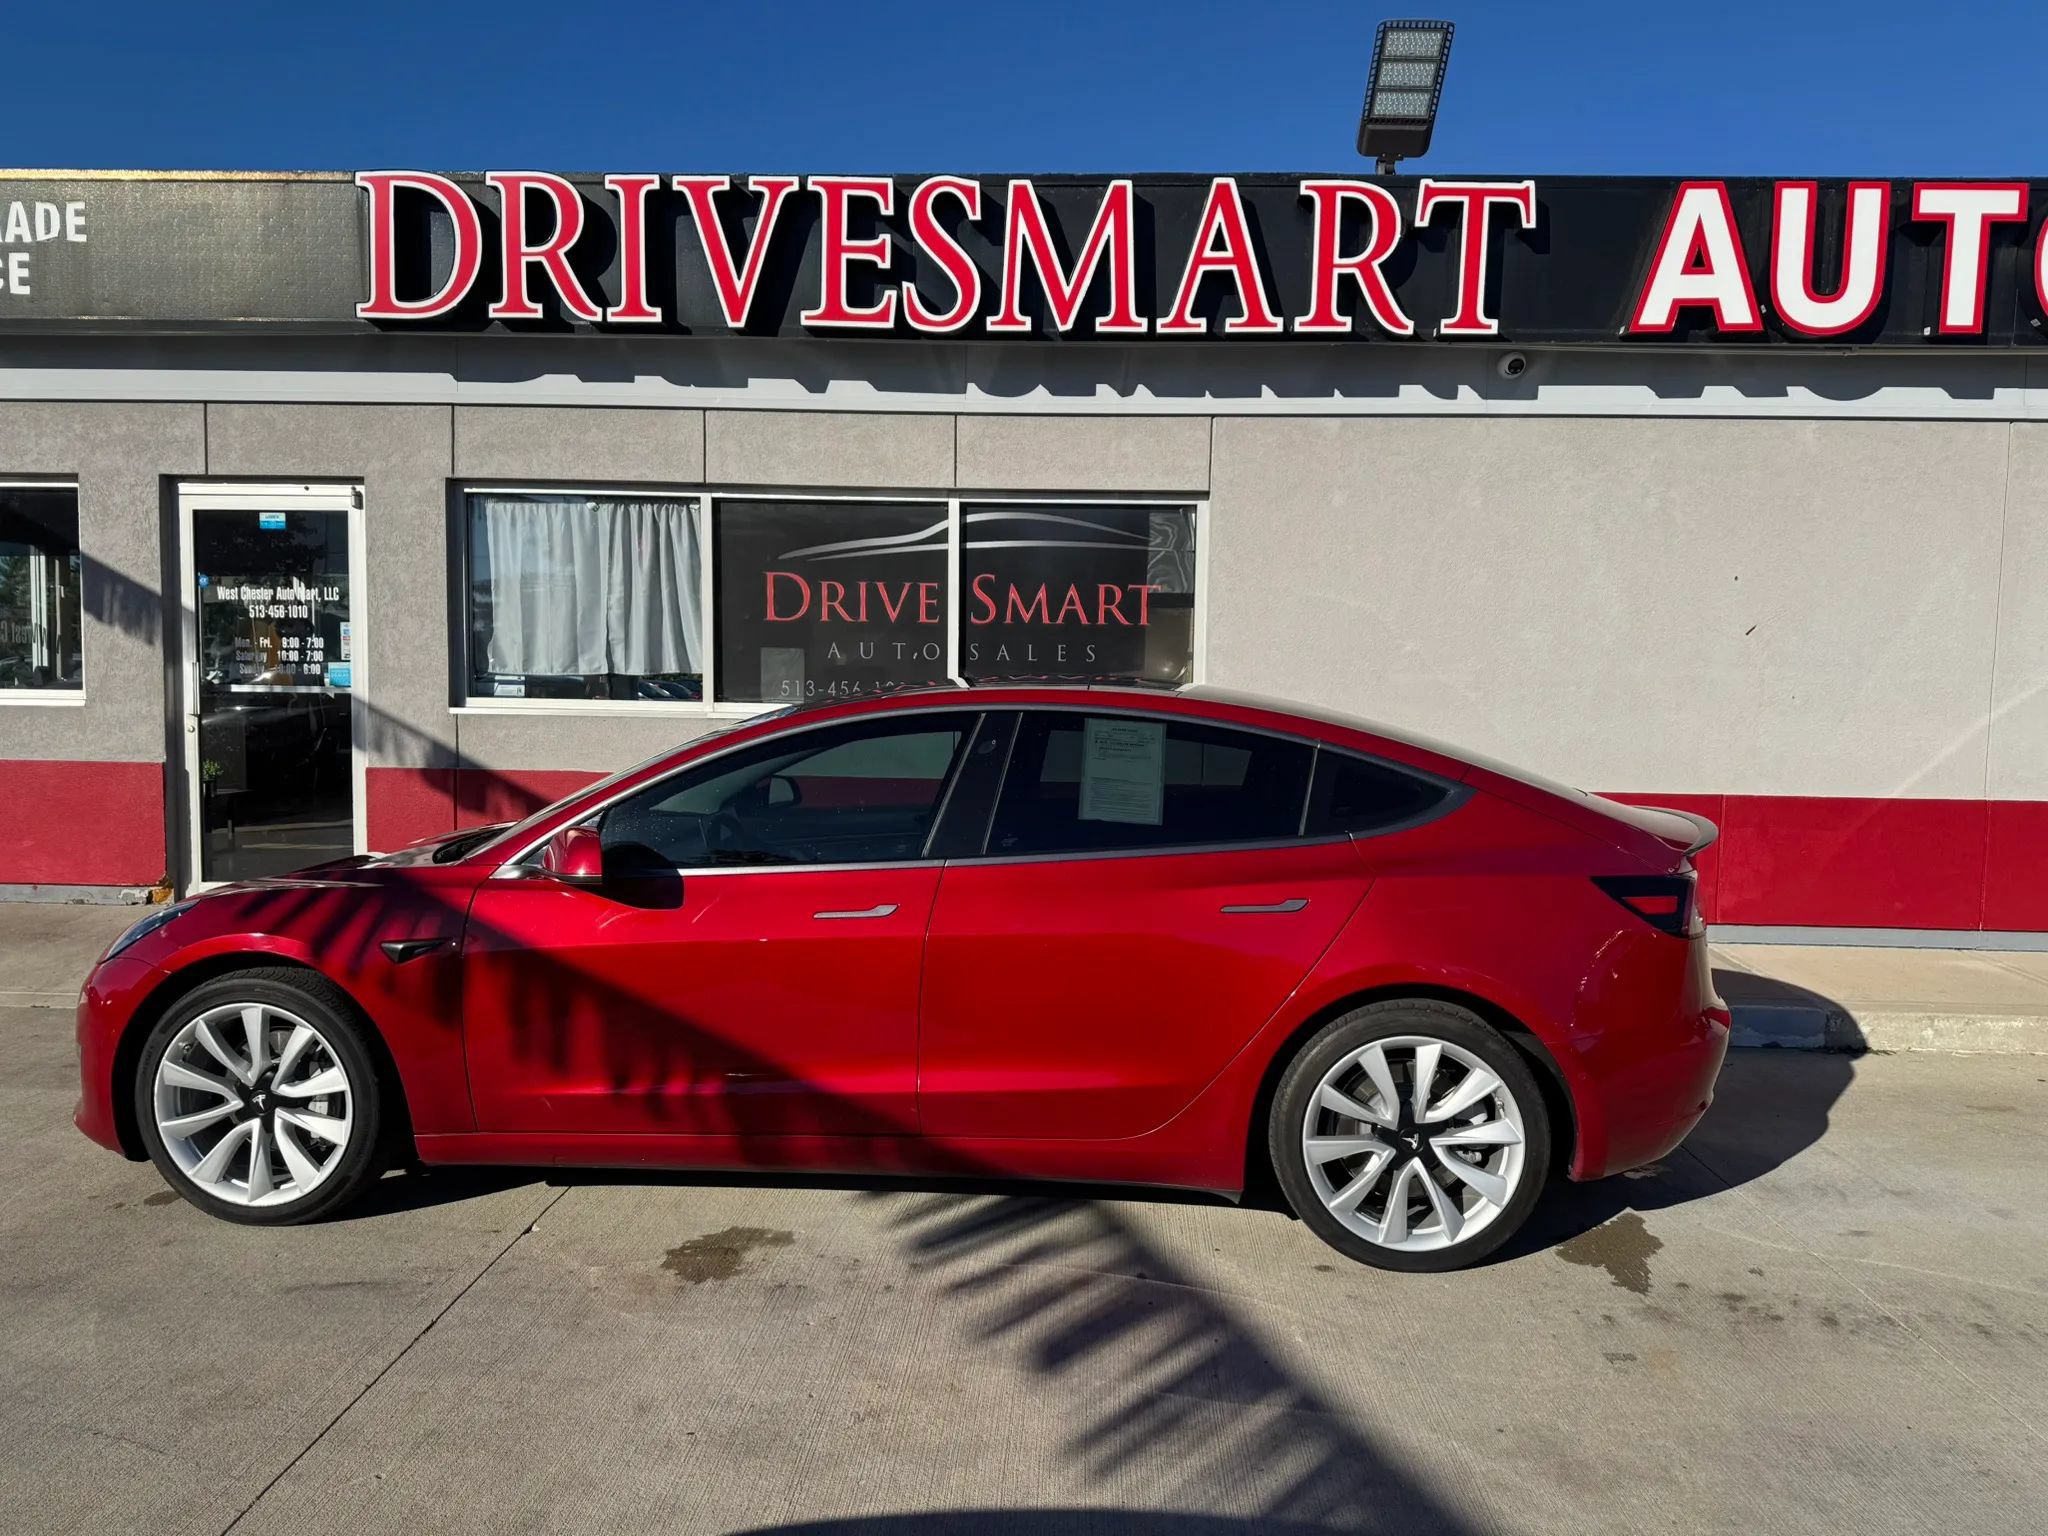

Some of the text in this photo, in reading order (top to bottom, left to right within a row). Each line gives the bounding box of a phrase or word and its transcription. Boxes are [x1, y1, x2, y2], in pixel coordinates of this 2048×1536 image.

[0, 201, 87, 243] ADE
[355, 170, 2048, 336] DRIVESMART AUT
[0, 252, 31, 295] E
[217, 586, 238, 600] West
[240, 586, 274, 600] Chester
[276, 586, 294, 600] Auto
[324, 586, 340, 600] LLC
[762, 571, 1162, 626] DRIVE SMART
[259, 636, 272, 648] Fri.
[306, 636, 324, 649] 7:00
[277, 650, 299, 662] 10:00
[306, 650, 323, 662] 7:00
[827, 641, 1096, 663] AUTO SALES
